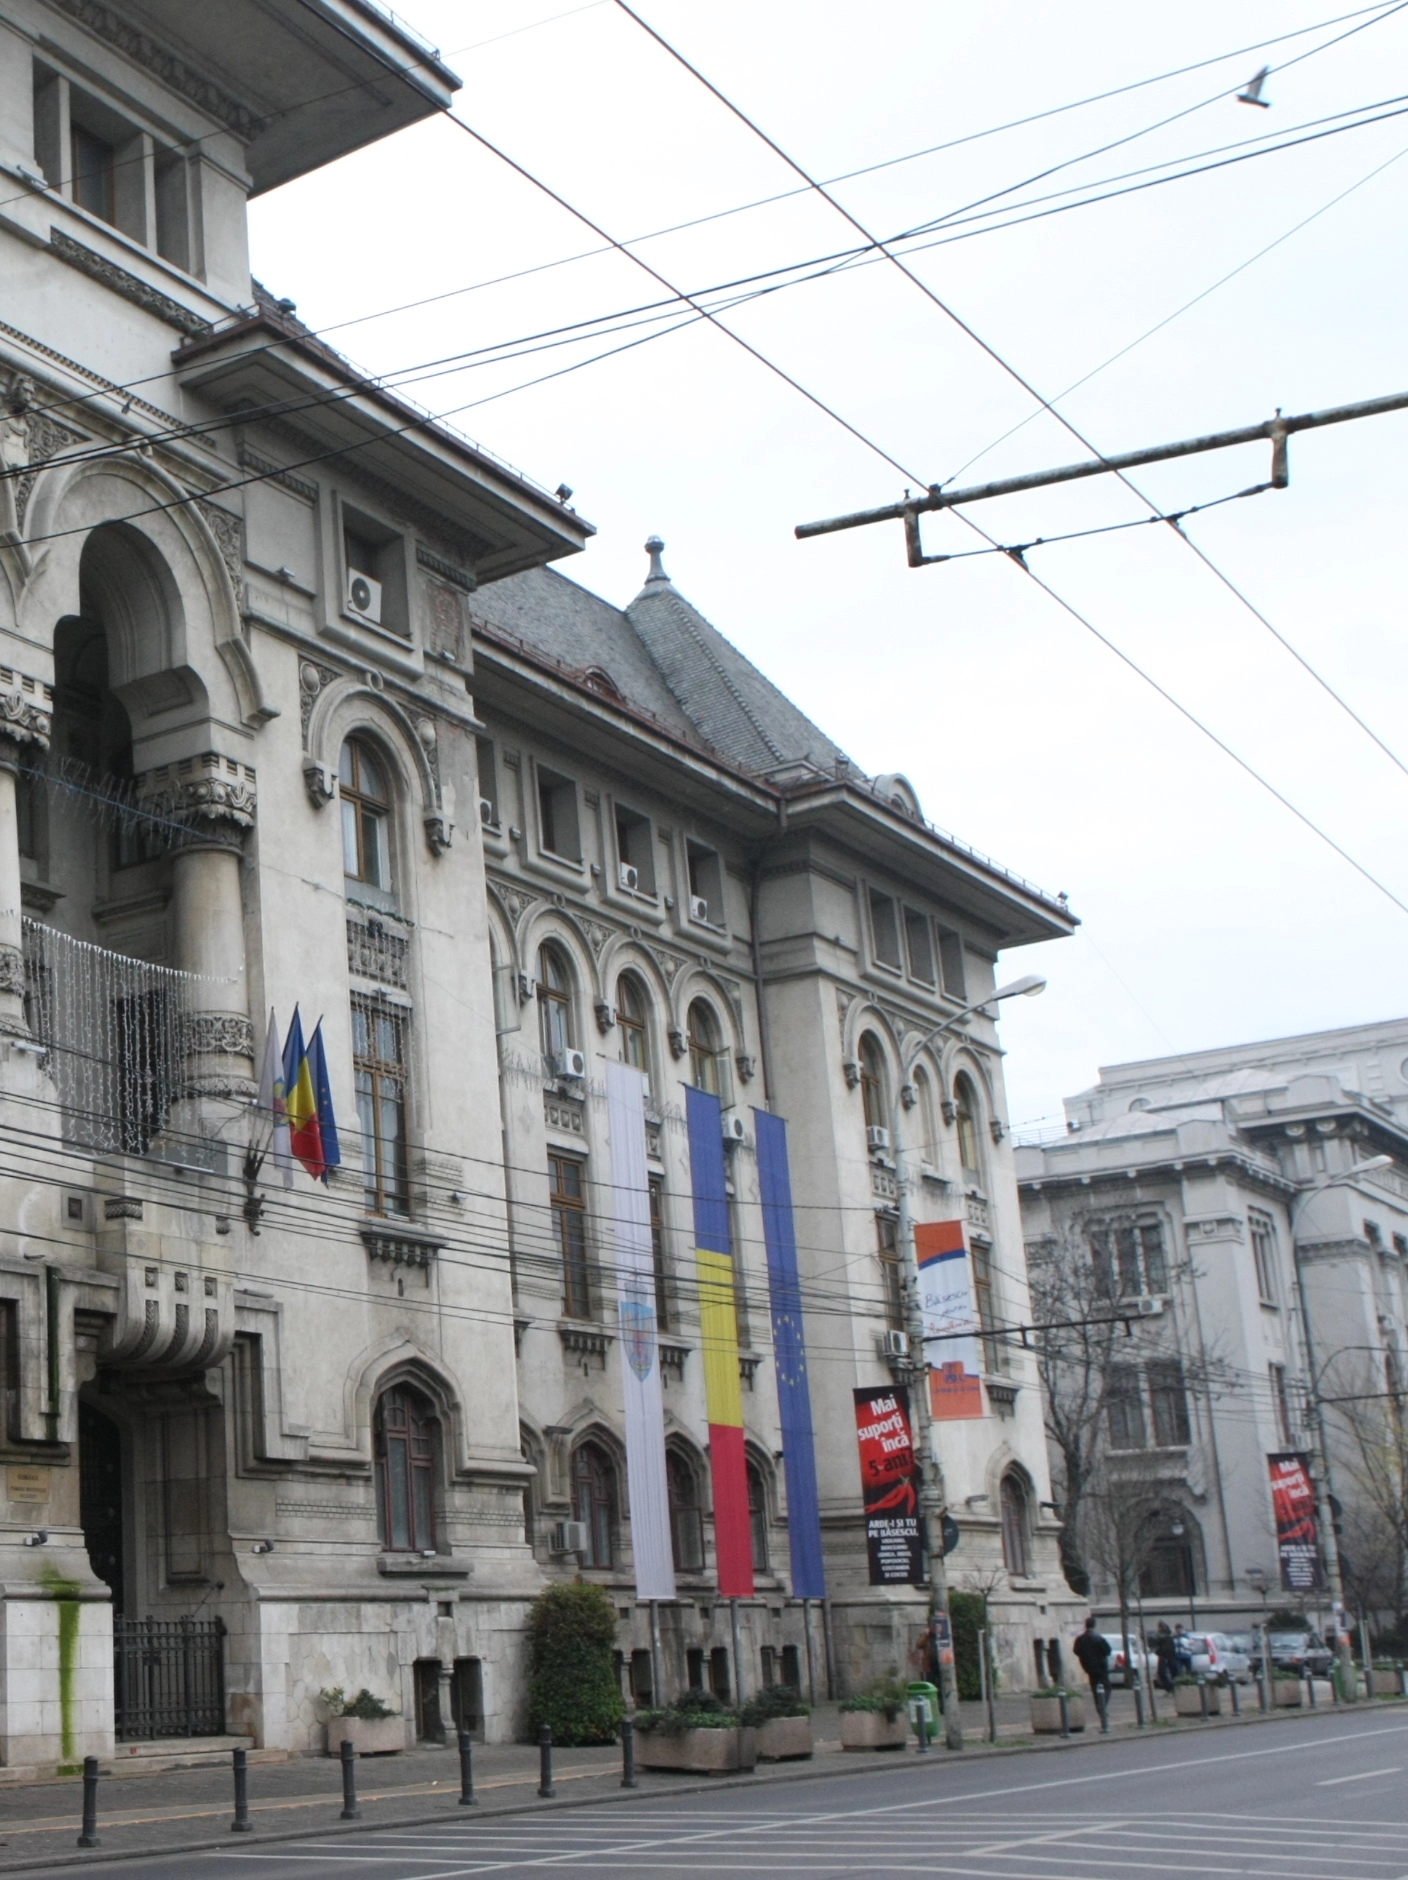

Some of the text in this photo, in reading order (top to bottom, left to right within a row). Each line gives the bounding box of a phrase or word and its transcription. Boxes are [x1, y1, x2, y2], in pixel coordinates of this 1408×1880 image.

[870, 1393, 898, 1416] Mai
[857, 1412, 904, 1441] suporți
[880, 1430, 910, 1453] încă
[869, 1460, 880, 1477] 5
[905, 1518, 917, 1527] TU
